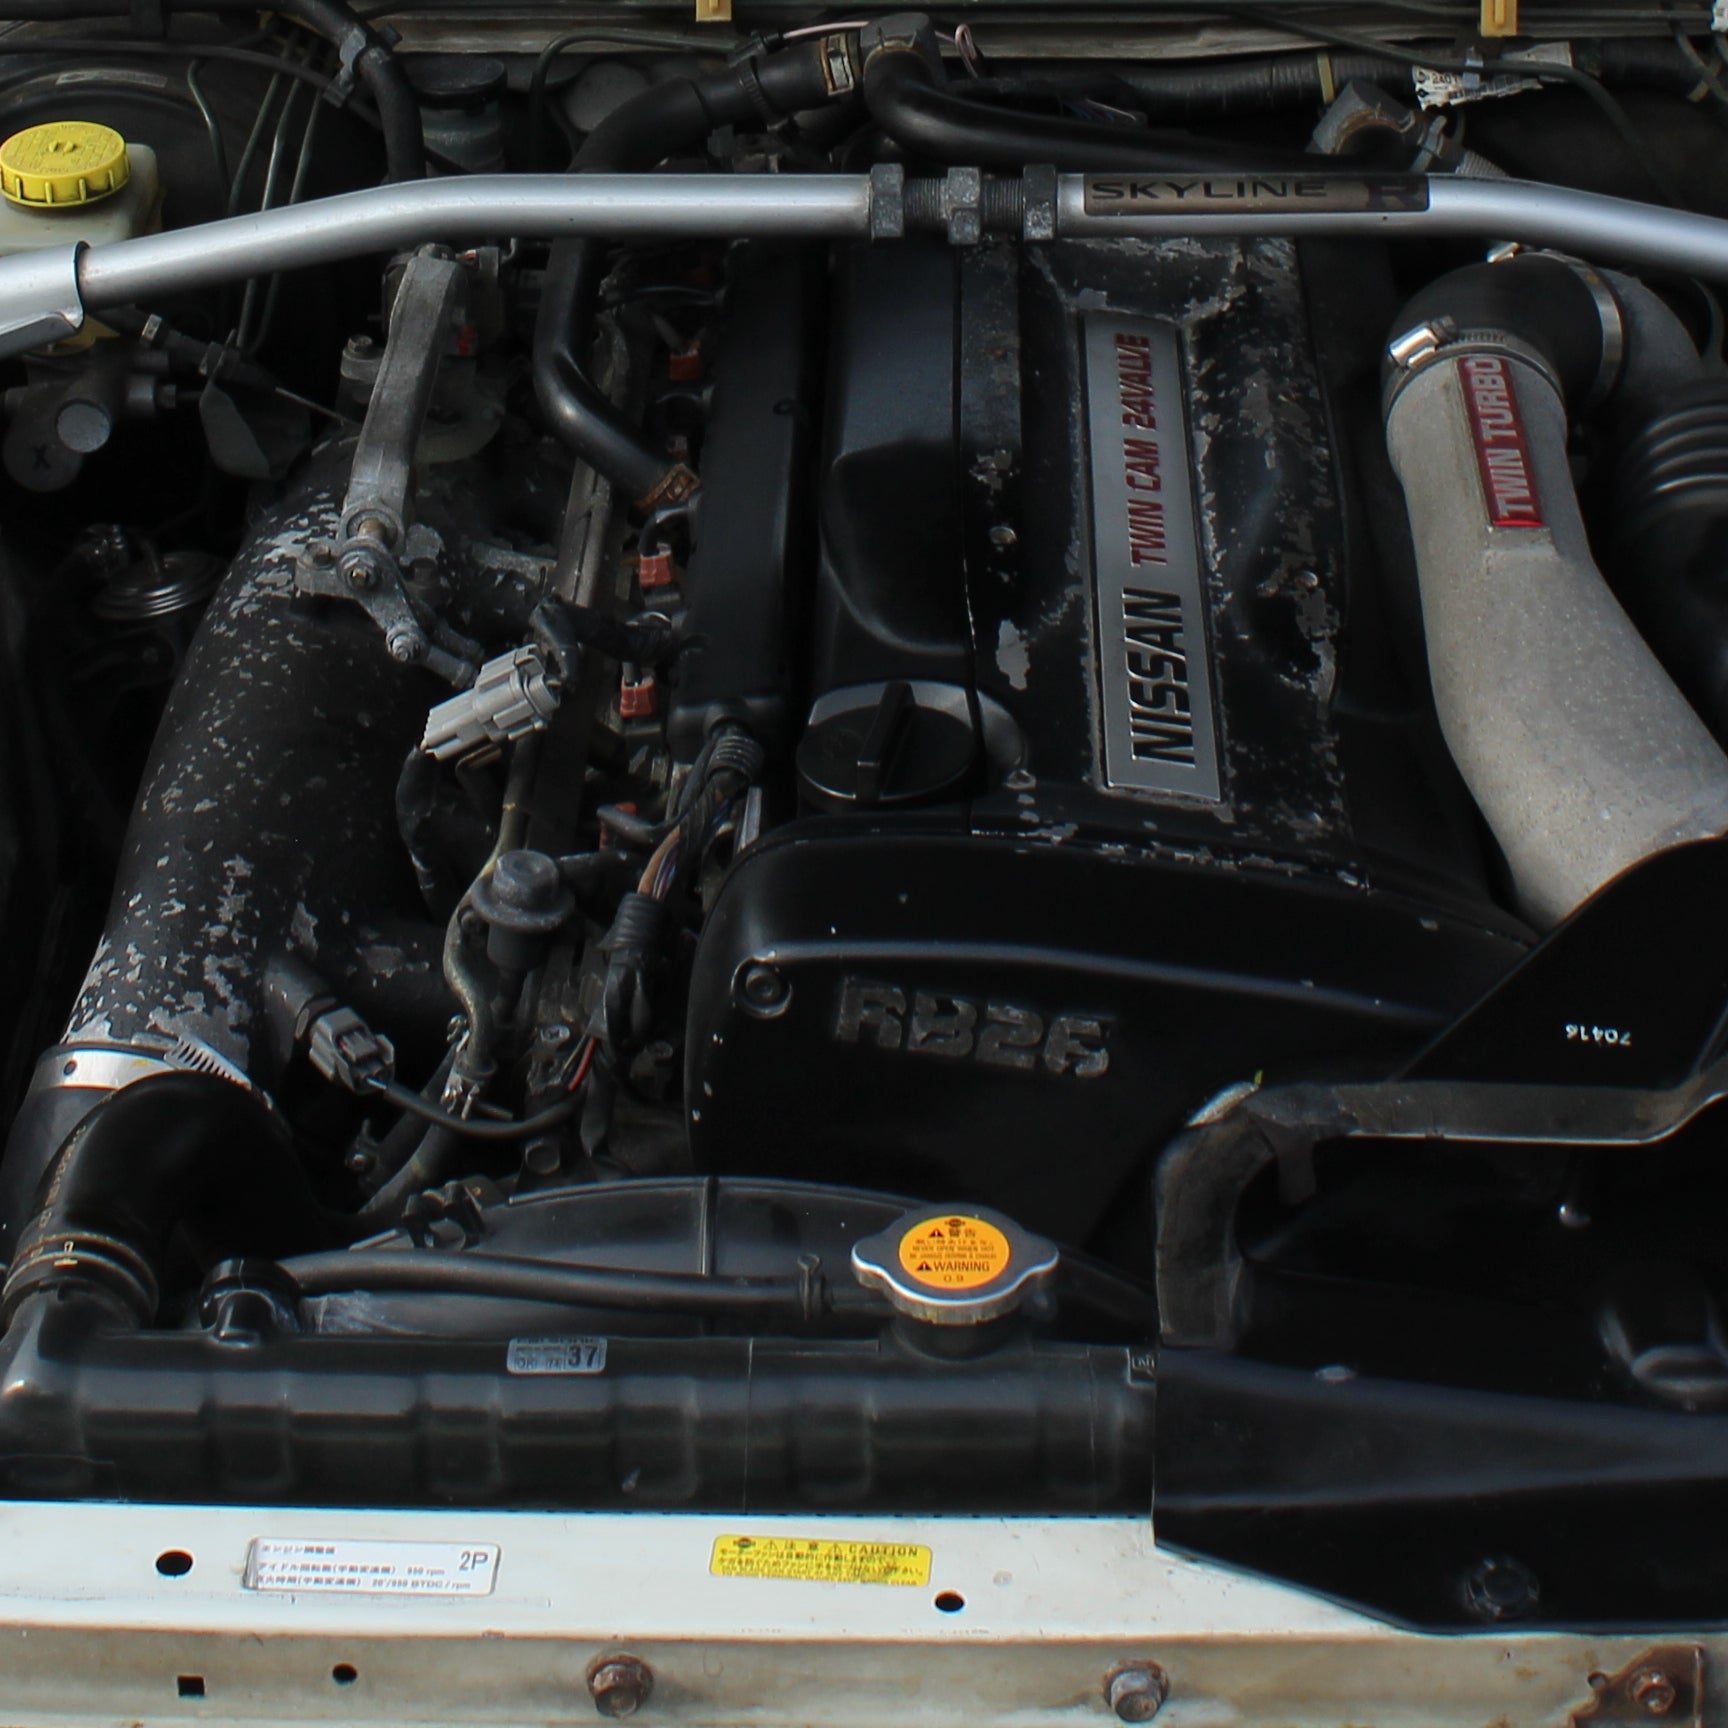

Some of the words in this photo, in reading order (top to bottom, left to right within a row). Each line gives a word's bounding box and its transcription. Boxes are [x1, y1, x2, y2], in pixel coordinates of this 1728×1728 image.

[1092, 180, 1327, 200] SKYLINE
[1115, 333, 1157, 431] 24VALVE
[1464, 357, 1518, 441] TURBO
[1123, 438, 1162, 493] CAM
[1485, 448, 1536, 517] TWIN
[1128, 499, 1167, 567] TWIN
[1122, 587, 1196, 768] NISSAN
[835, 975, 1117, 1080] RB26
[1565, 1023, 1632, 1046] 70416
[934, 1260, 990, 1272] WARNING
[568, 1345, 599, 1368] 37
[458, 1550, 489, 1572] 2P
[848, 1543, 918, 1557] CAUTION
